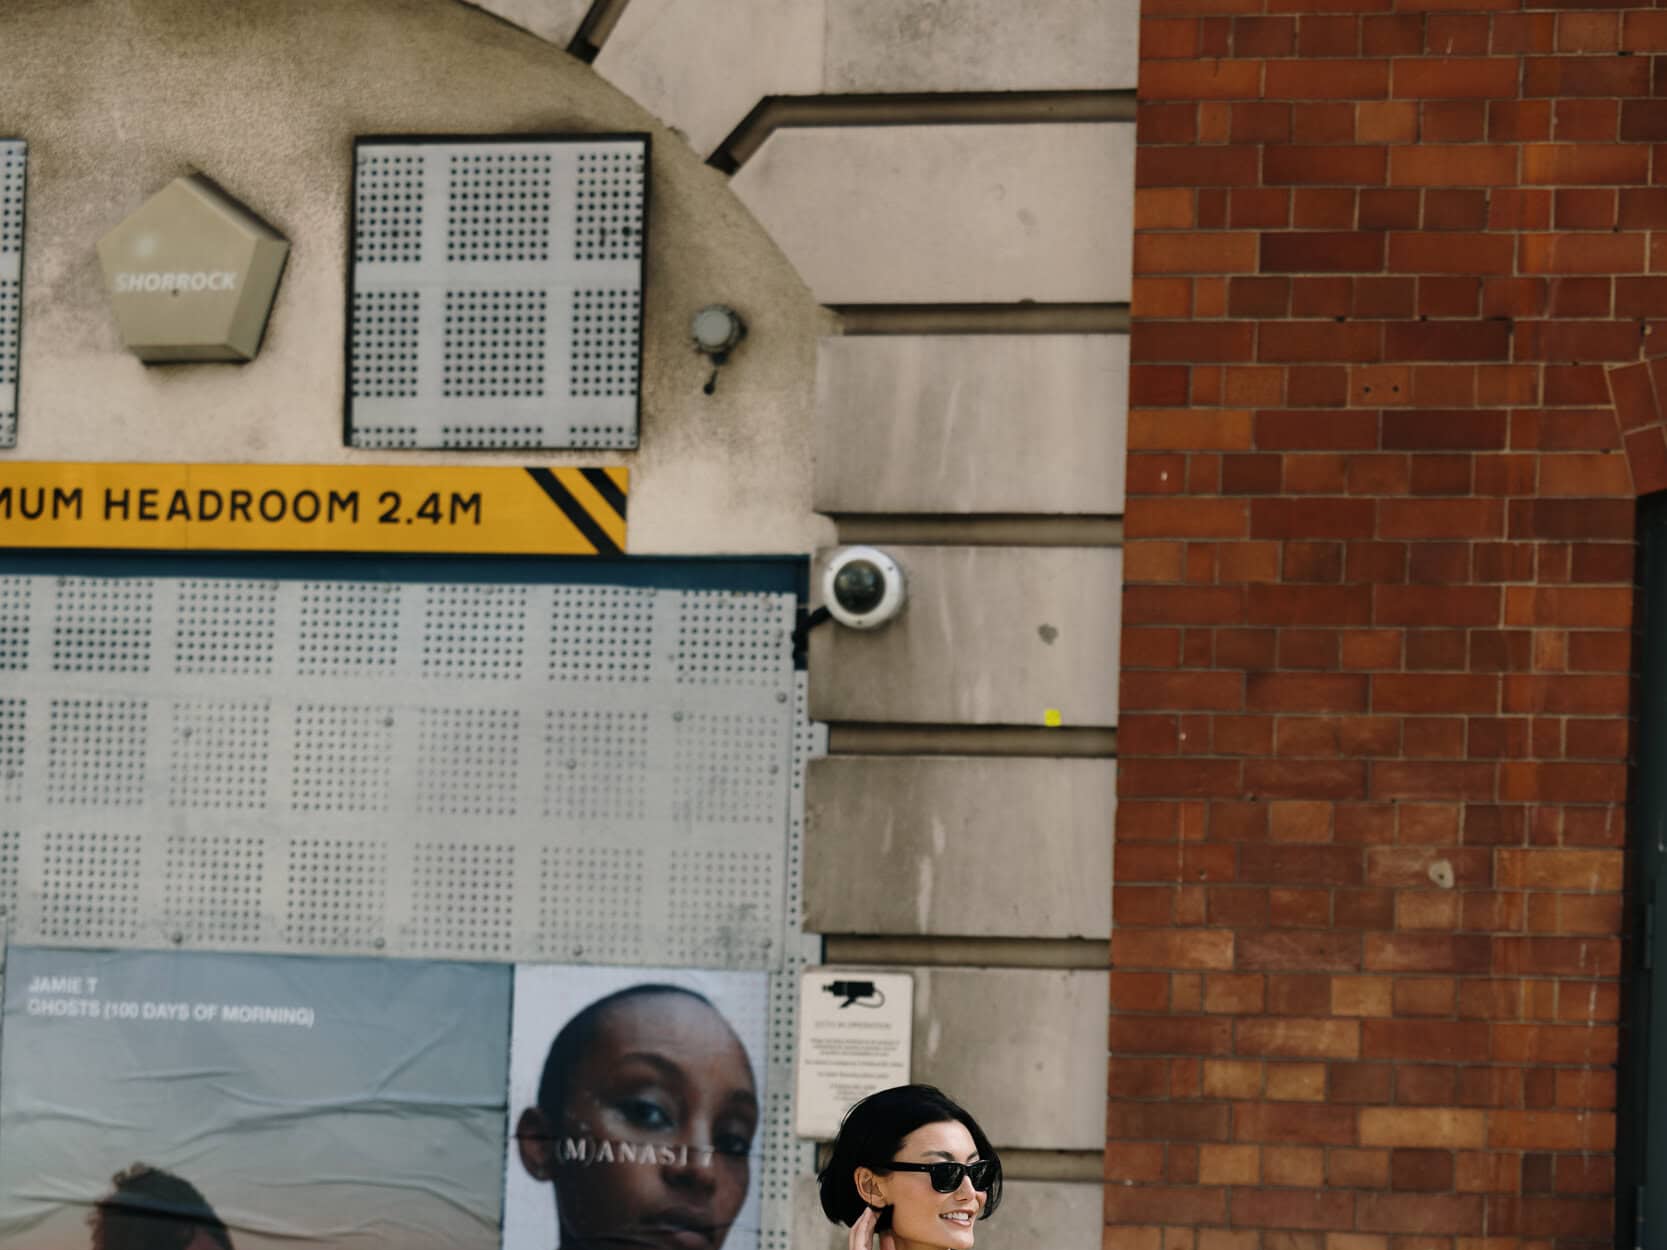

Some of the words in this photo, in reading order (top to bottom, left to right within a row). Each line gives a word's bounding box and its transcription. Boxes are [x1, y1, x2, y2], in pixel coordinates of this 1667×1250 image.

[115, 271, 239, 292] SHORROCK
[104, 488, 360, 523] HEADROOM
[377, 491, 482, 525] 2.4M
[28, 976, 82, 994] JAMIE
[86, 977, 98, 994] T
[27, 998, 101, 1017] GHOSTS
[104, 1001, 139, 1020] (100
[142, 1002, 190, 1021] DAYS
[194, 1004, 218, 1022] OF
[221, 1005, 315, 1028] MORNING)
